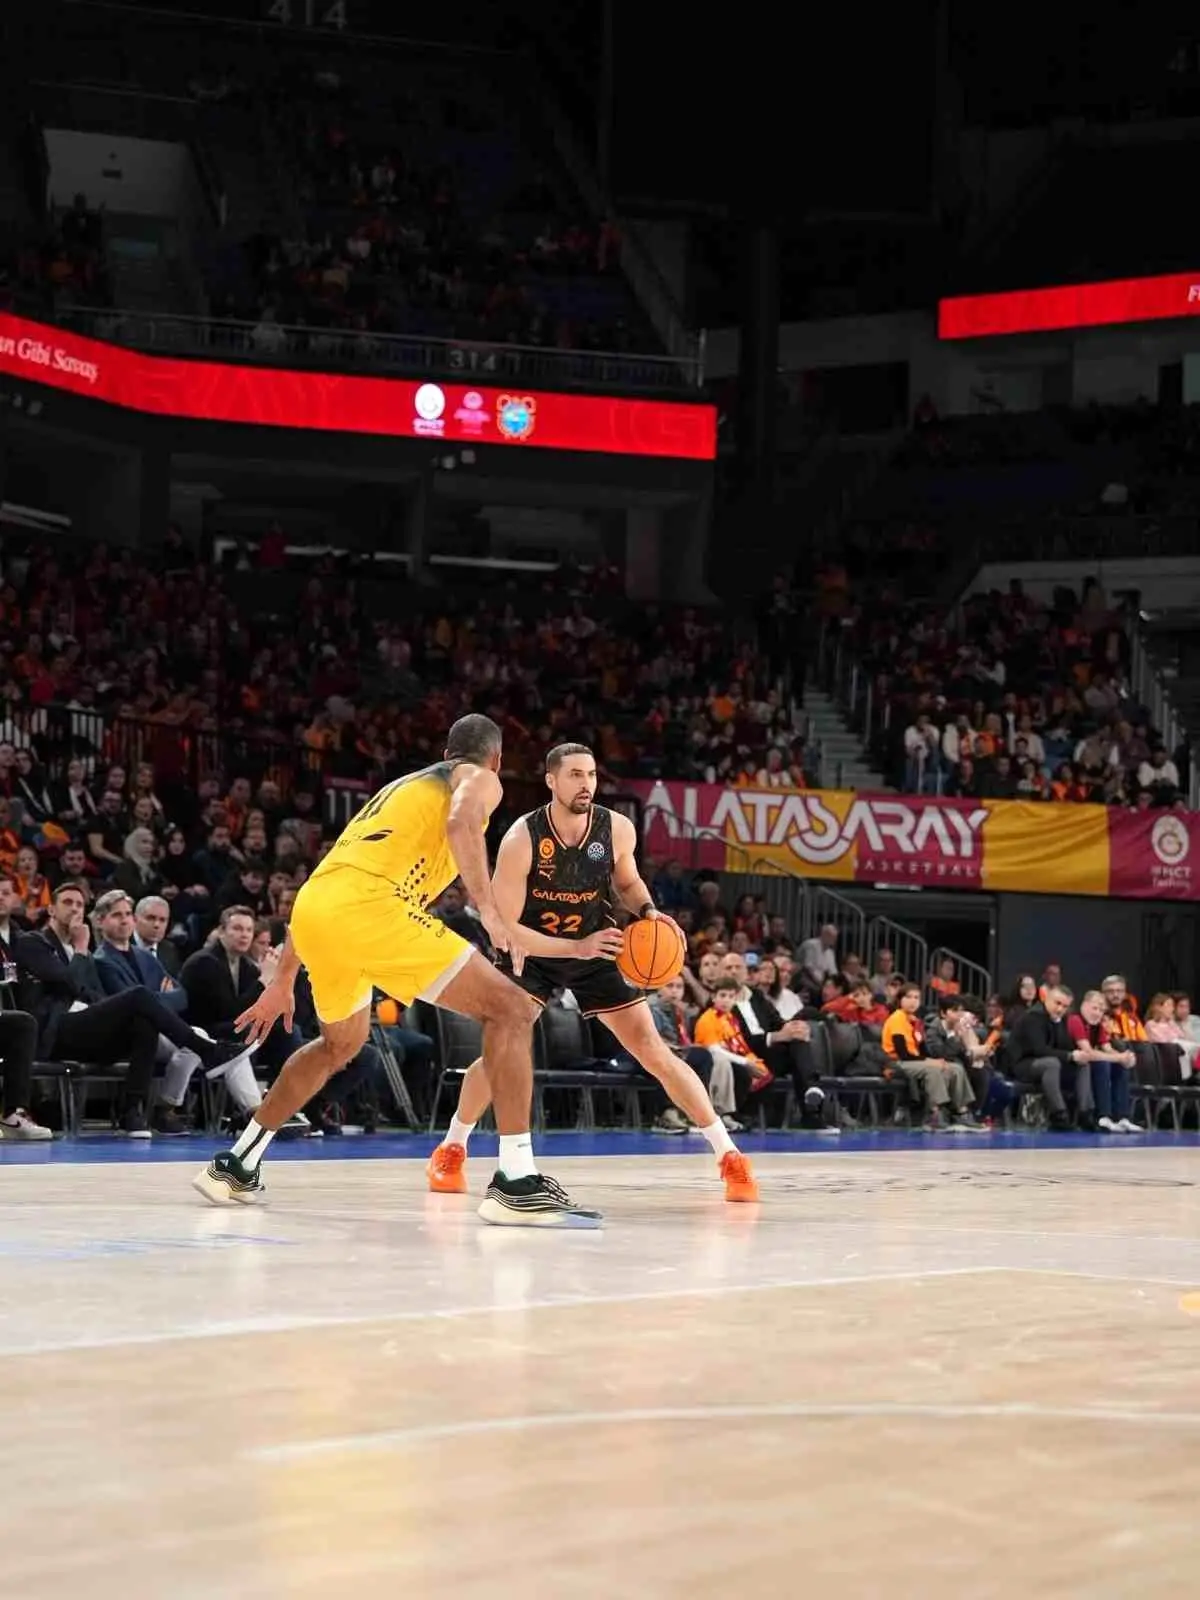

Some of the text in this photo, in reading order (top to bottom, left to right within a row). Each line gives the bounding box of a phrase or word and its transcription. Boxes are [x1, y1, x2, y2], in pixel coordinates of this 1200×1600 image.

[17, 338, 52, 366] Gibi
[449, 350, 496, 371] 314
[643, 781, 989, 864] ALATASARAY
[532, 888, 600, 905] GALATASAR
[540, 911, 583, 934] 22
